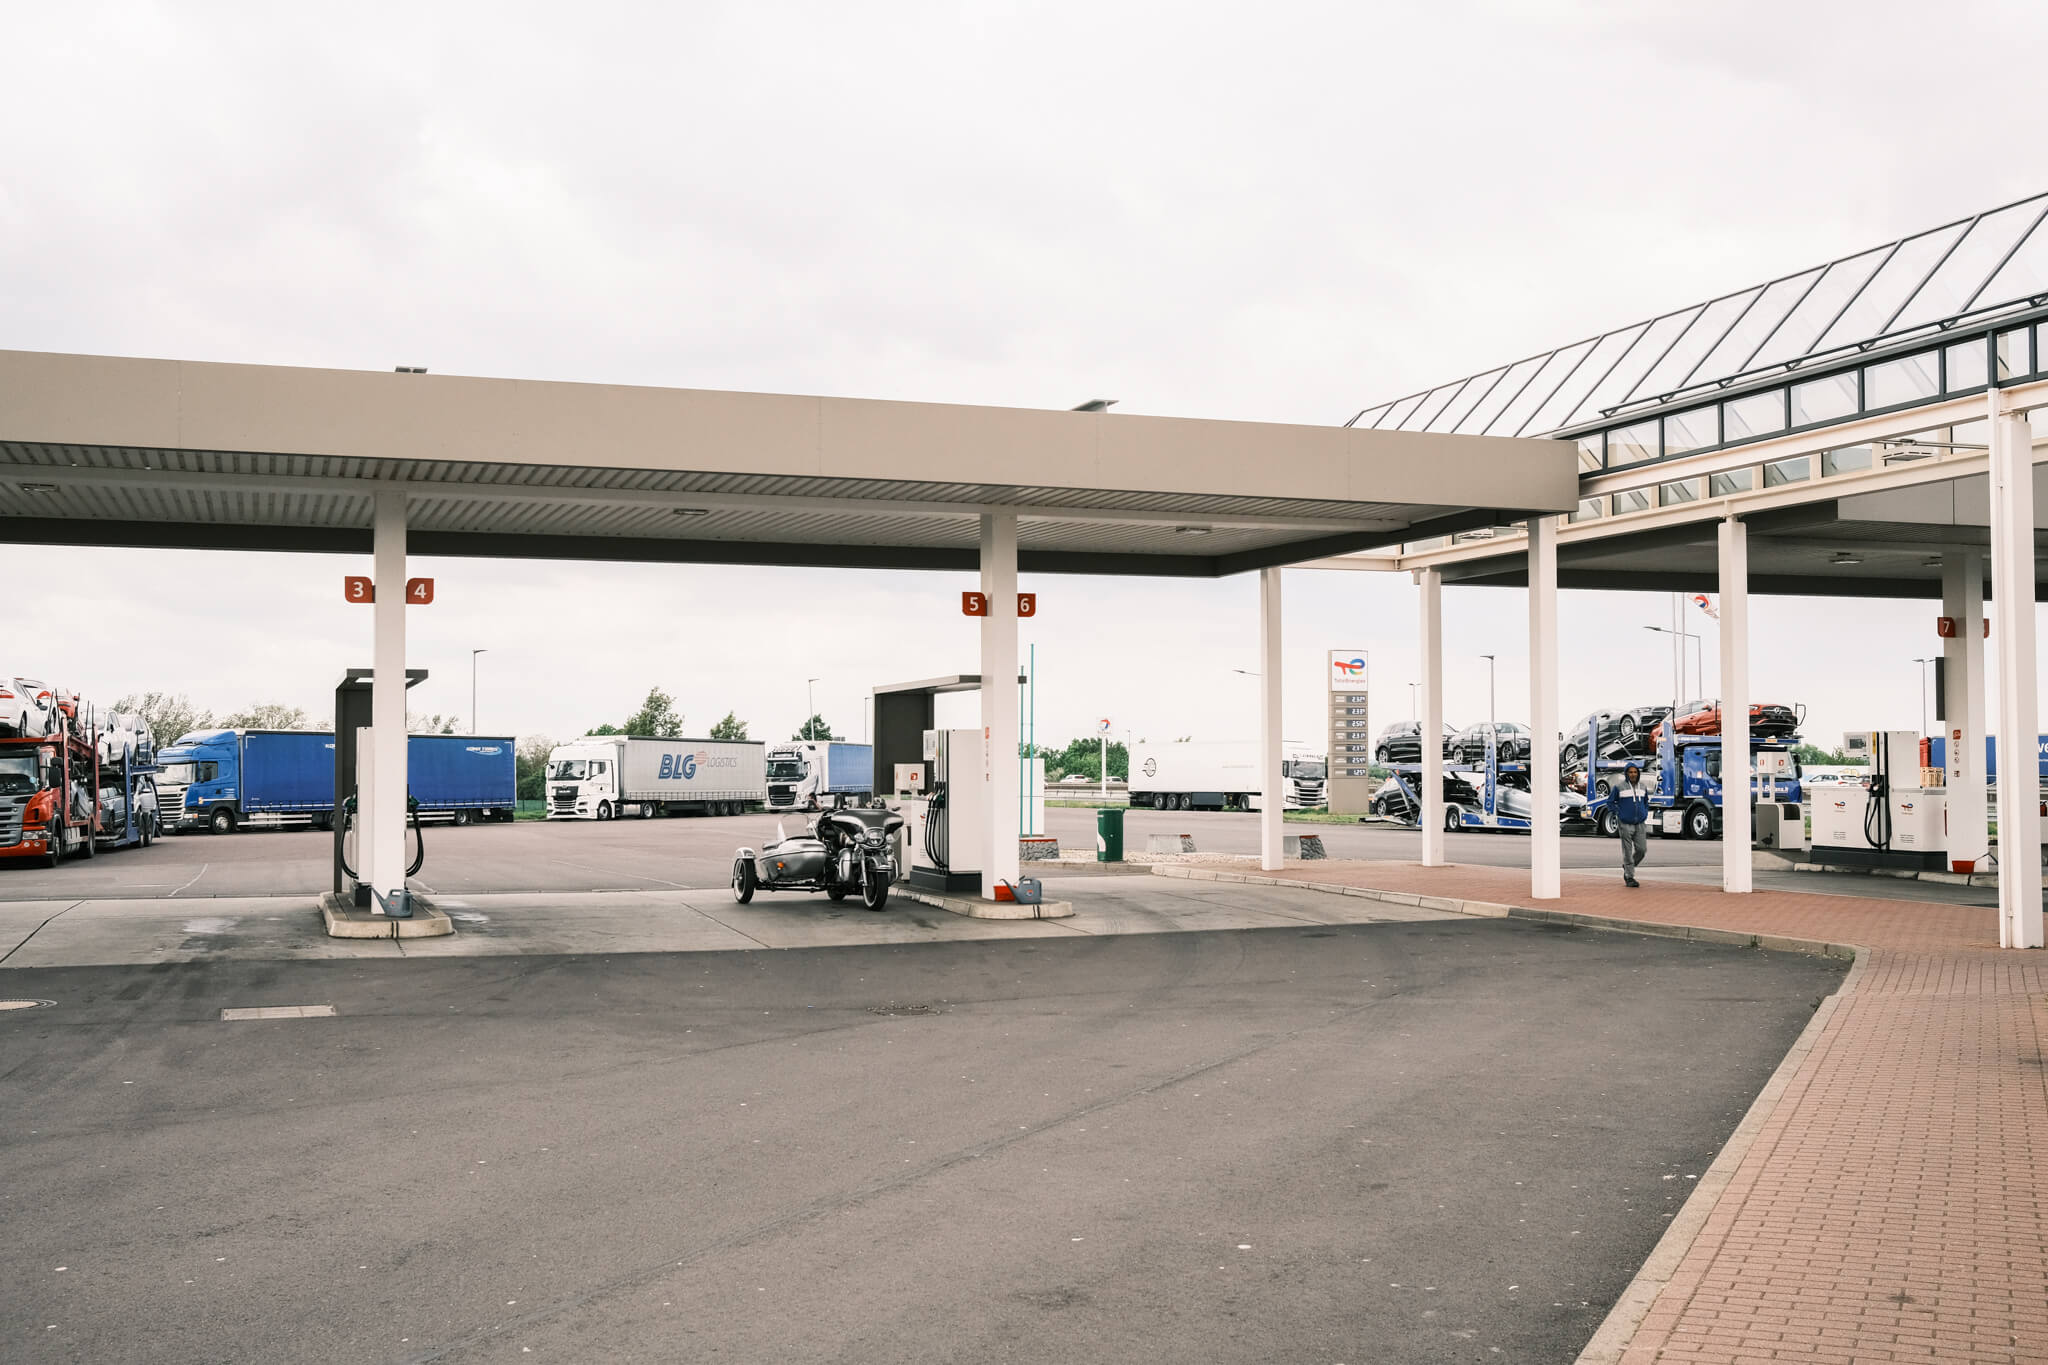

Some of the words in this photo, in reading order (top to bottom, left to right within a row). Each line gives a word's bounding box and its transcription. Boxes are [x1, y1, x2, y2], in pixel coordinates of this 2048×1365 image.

[352, 581, 364, 598] 3
[414, 583, 427, 599] 4
[969, 596, 979, 612] 5
[1020, 598, 1030, 612] 6
[1943, 620, 1950, 633] 7
[658, 753, 697, 780] BLG
[707, 757, 737, 768] LOGISTICS
